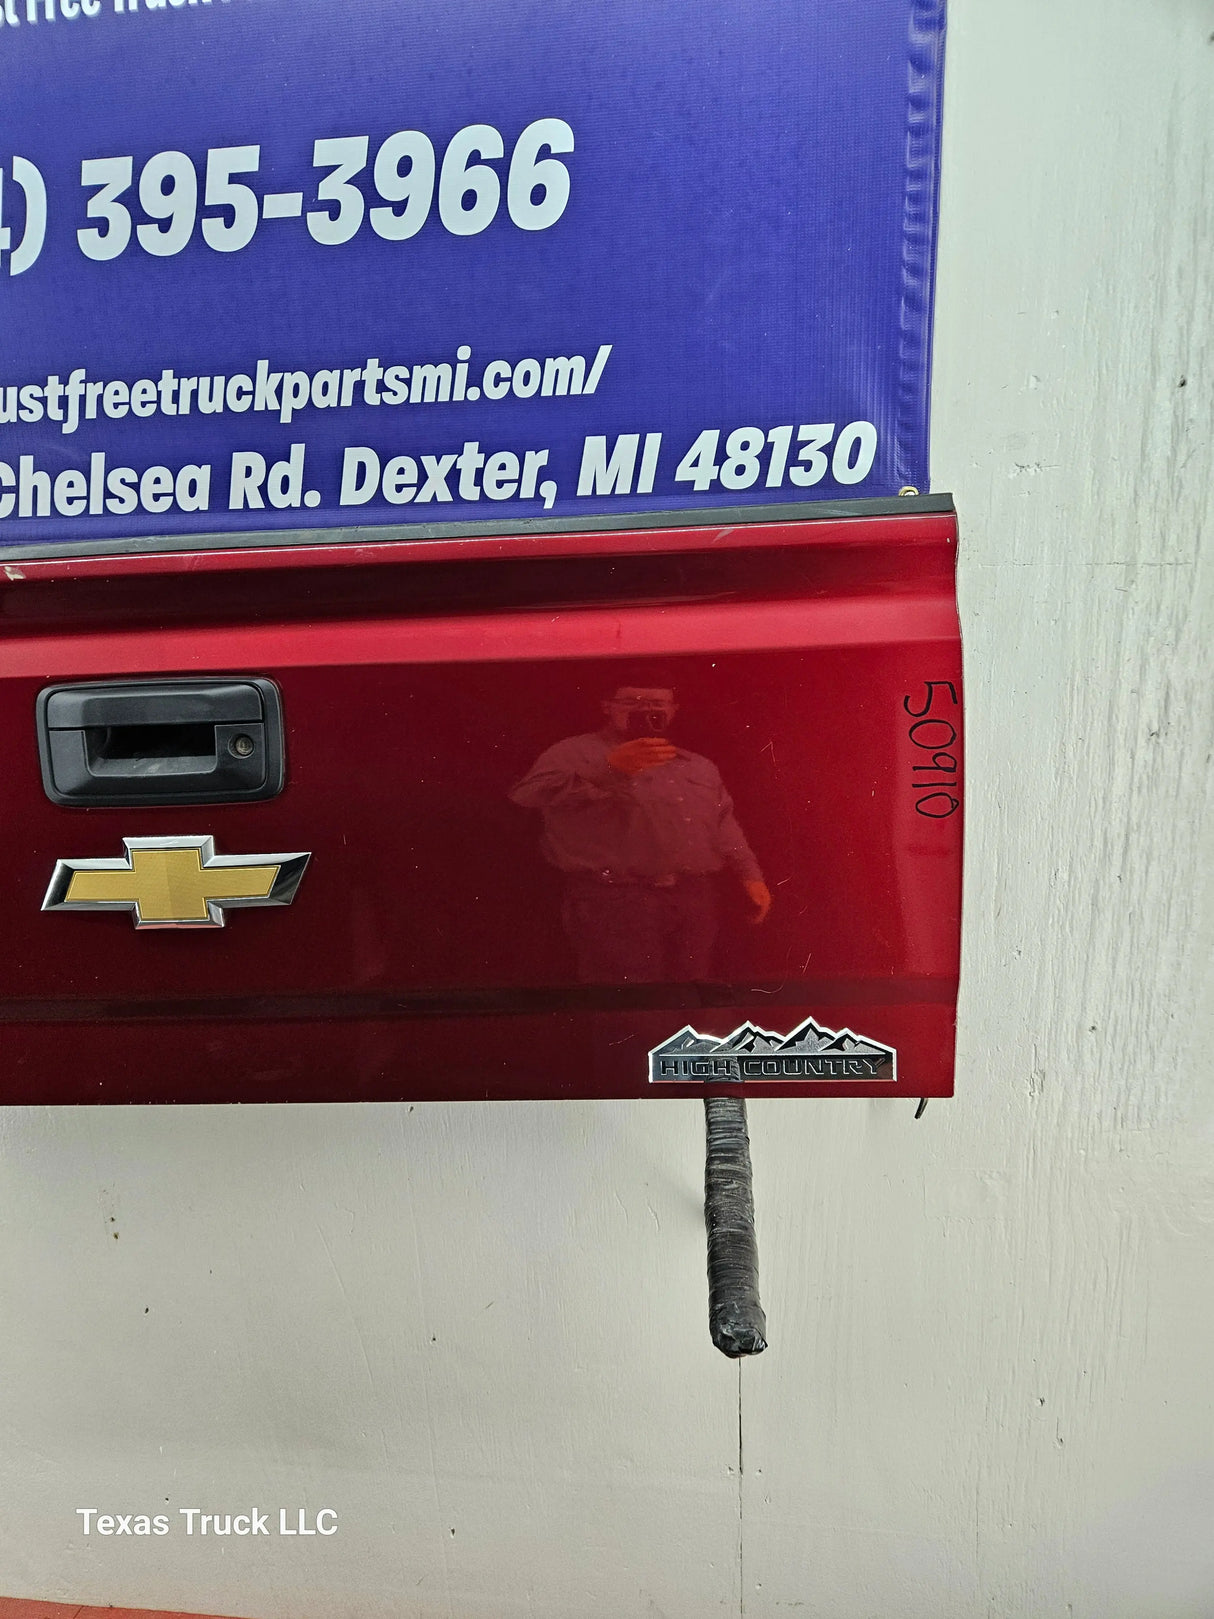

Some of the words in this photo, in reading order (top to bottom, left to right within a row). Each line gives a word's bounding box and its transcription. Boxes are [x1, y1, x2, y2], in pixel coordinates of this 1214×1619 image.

[77, 118, 575, 261] 395-3966
[228, 443, 321, 510] Rd.
[339, 442, 558, 510] Dexter,
[576, 432, 663, 497] MI
[674, 420, 878, 491] 48130
[659, 1059, 732, 1077] HIGH
[743, 1057, 887, 1076] COUNTRY
